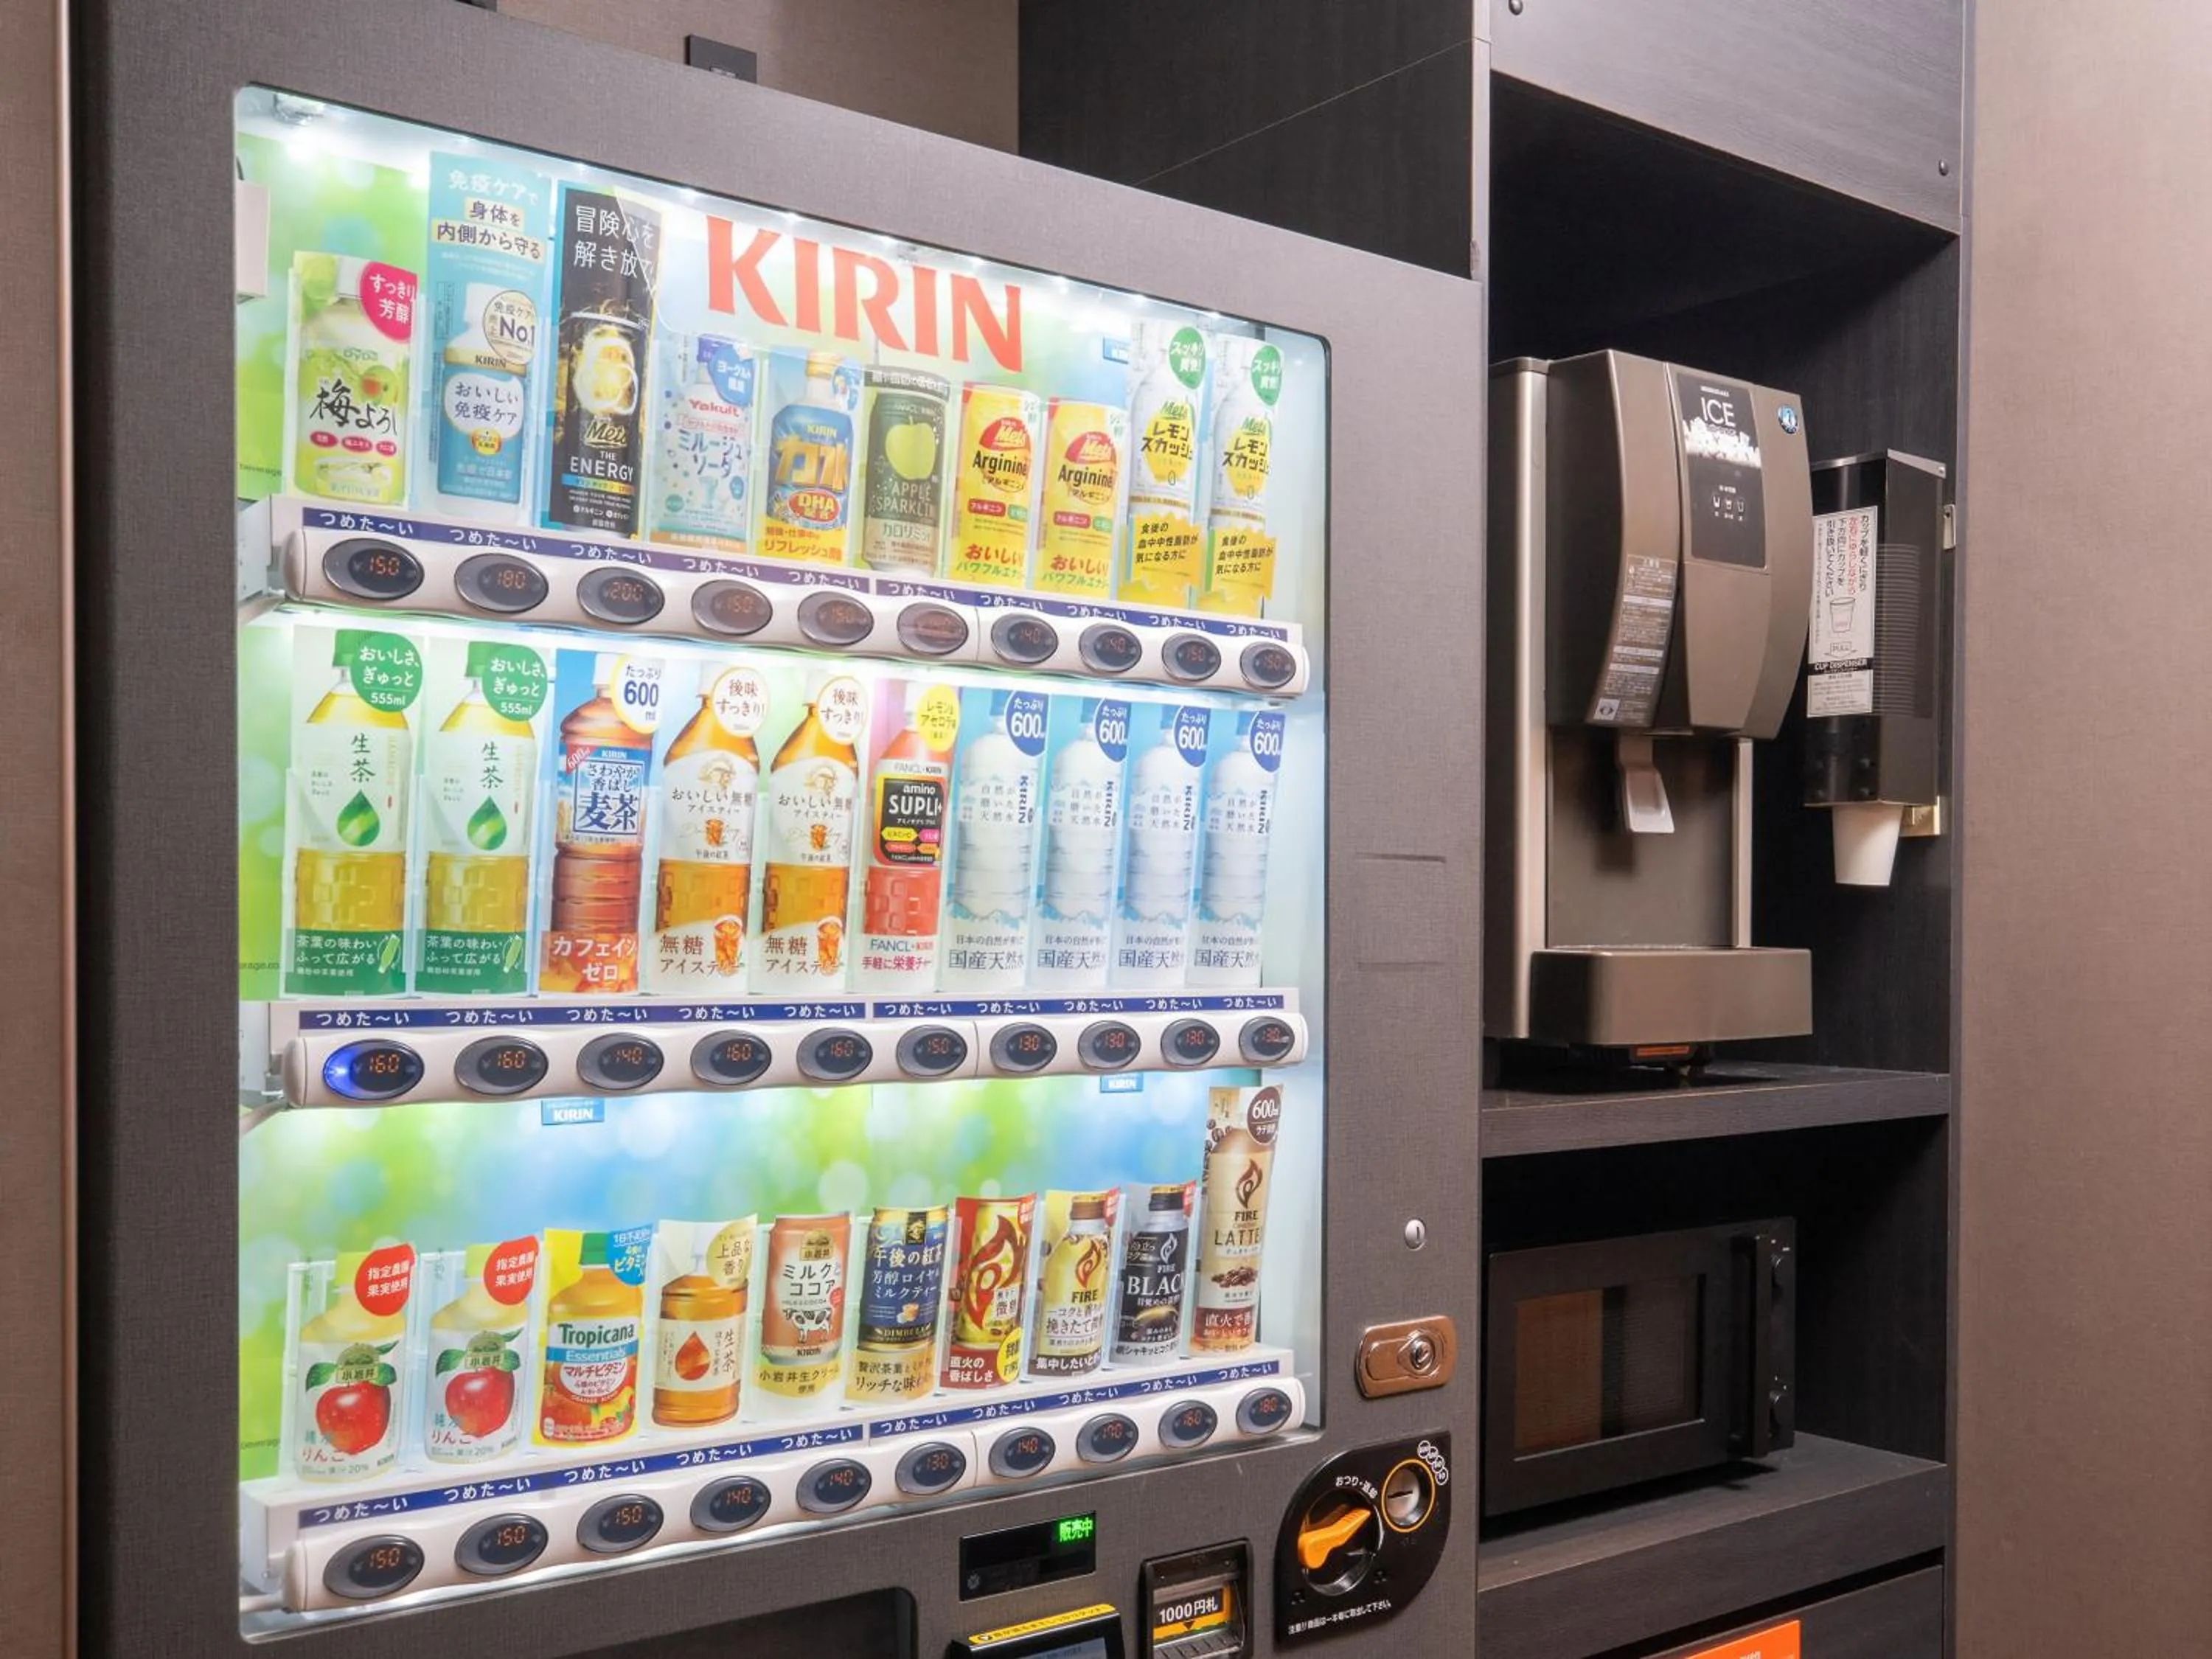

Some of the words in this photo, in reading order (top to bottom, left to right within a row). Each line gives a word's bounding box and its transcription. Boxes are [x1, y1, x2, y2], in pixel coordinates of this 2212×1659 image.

[469, 201, 520, 226] 身体を
[576, 206, 655, 249] 冒険心を
[437, 222, 541, 260] 内側から守る
[706, 215, 1022, 373] KIRIN
[475, 355, 507, 368] KIRIN
[455, 382, 518, 403] おいしい
[455, 402, 517, 425] 免疫ケア
[689, 397, 740, 418] Yakult
[1700, 397, 1736, 427] ICE
[1152, 421, 1192, 442] レモン
[1234, 437, 1267, 456] レモン
[599, 451, 616, 461] THE
[973, 451, 1028, 476] Arginine
[570, 456, 634, 481] ENERGY
[692, 454, 733, 479] ソーダ
[1058, 465, 1113, 488] Arginine
[891, 481, 931, 502] APPLE
[799, 493, 834, 509] DHA
[320, 512, 413, 536] つめた〜い
[1141, 522, 1169, 535] 食後の
[450, 529, 537, 551] つめた〜い
[571, 544, 652, 565] つめた〜い
[1135, 549, 1186, 564] 気になる方に
[369, 556, 400, 576] 150
[684, 558, 759, 578] つめた〜い
[497, 569, 526, 590] 180
[788, 571, 860, 590] つめた〜い
[608, 582, 643, 602] 200
[888, 582, 956, 602] つめた〜い
[981, 594, 1044, 612] つめた〜い
[1067, 605, 1127, 621] つめた〜い
[1150, 614, 1206, 631] つめた〜い
[1227, 624, 1281, 639] つめた〜い
[359, 645, 420, 668] おいしさ、
[490, 656, 546, 678] おいしさ、
[626, 664, 661, 681] たっぷり
[1815, 661, 1828, 671] CUP
[362, 666, 414, 687] ぎゅっと
[493, 675, 541, 697] ぎゅっと
[623, 679, 659, 707] 600
[729, 680, 759, 698] 後味
[371, 692, 406, 706] 555ml
[832, 689, 858, 705] 後味
[1014, 698, 1043, 712] たっぷり
[500, 700, 533, 716] 555ml
[1102, 706, 1127, 717] たっぷり
[1011, 712, 1041, 738] 600
[1181, 712, 1207, 725] たっぷり
[1256, 719, 1281, 731] たっぷり
[1099, 720, 1125, 744] 600
[1179, 726, 1205, 749] 600
[1254, 733, 1279, 756] 600
[349, 732, 377, 784] 生茶
[601, 750, 627, 759] KIRIN
[479, 740, 504, 789] 生茶
[588, 763, 640, 780] さわやか
[591, 777, 634, 793] 香ばし
[903, 785, 936, 794] amino
[577, 792, 639, 831] 麦茶
[296, 935, 378, 950] 茶葉の味わい
[426, 935, 504, 950] 茶葉の味わい
[553, 937, 637, 958] カフェイン
[660, 934, 703, 956] 無糖
[765, 936, 807, 956] 無糖
[870, 939, 911, 951] FANCL
[296, 952, 375, 964] ふって広がる
[425, 952, 501, 964] ふって広がる
[582, 963, 618, 982] ゼロ
[884, 1002, 953, 1015] つめた〜い
[977, 1001, 1040, 1015] つめた〜い
[1064, 1000, 1124, 1012] つめた〜い
[1145, 998, 1203, 1010] つめた〜い
[1223, 996, 1277, 1009] つめた〜い
[316, 1011, 410, 1027] つめた〜い
[445, 1009, 534, 1025] つめた〜い
[566, 1006, 647, 1022] つめた〜い
[678, 1007, 755, 1020] つめた〜い
[784, 1005, 856, 1018] つめた〜い
[830, 1040, 854, 1056] 160
[928, 1037, 950, 1054] 150
[1018, 1035, 1040, 1051] 130
[497, 1050, 526, 1068] 160
[614, 1047, 643, 1064] 140
[726, 1043, 751, 1061] 160
[369, 1053, 400, 1073] 160
[1108, 1078, 1138, 1090] KIRIN
[553, 1108, 594, 1121] KIRIN
[1234, 1210, 1258, 1222] FIRE
[1214, 1227, 1261, 1247] LATTE
[1157, 1265, 1175, 1273] FIRE
[495, 1270, 534, 1287] 果実使用
[366, 1279, 409, 1298] 果実使用
[790, 1280, 835, 1297] ココア
[1071, 1289, 1098, 1304] FIRE
[557, 1324, 635, 1348] Tropicana
[470, 1356, 501, 1367] 小岩井
[566, 1347, 627, 1361] Essentials
[950, 1357, 984, 1368] 直火の
[342, 1368, 375, 1380] 小岩井
[565, 1363, 626, 1378] マルチビタミン
[950, 1371, 993, 1383] 香ばしさ
[1217, 1364, 1272, 1380] つめた〜い
[1141, 1375, 1197, 1392] つめた〜い
[1060, 1388, 1119, 1405] つめた〜い
[973, 1400, 1035, 1419] つめた〜い
[880, 1414, 948, 1434] つめた〜い
[781, 1429, 852, 1449] つめた〜い
[1017, 1437, 1037, 1454] 140
[676, 1444, 752, 1466] つめた〜い
[926, 1453, 948, 1470] 130
[564, 1460, 646, 1483] つめた〜い
[830, 1470, 853, 1486] 140
[444, 1478, 530, 1502] つめた〜い
[725, 1488, 751, 1505] 140
[315, 1497, 408, 1523] つめた〜い
[614, 1505, 643, 1526] 150
[497, 1526, 526, 1546] 150
[1059, 1517, 1093, 1543] 販売中
[369, 1548, 400, 1569] 150
[1160, 1596, 1217, 1624] 1000円札
